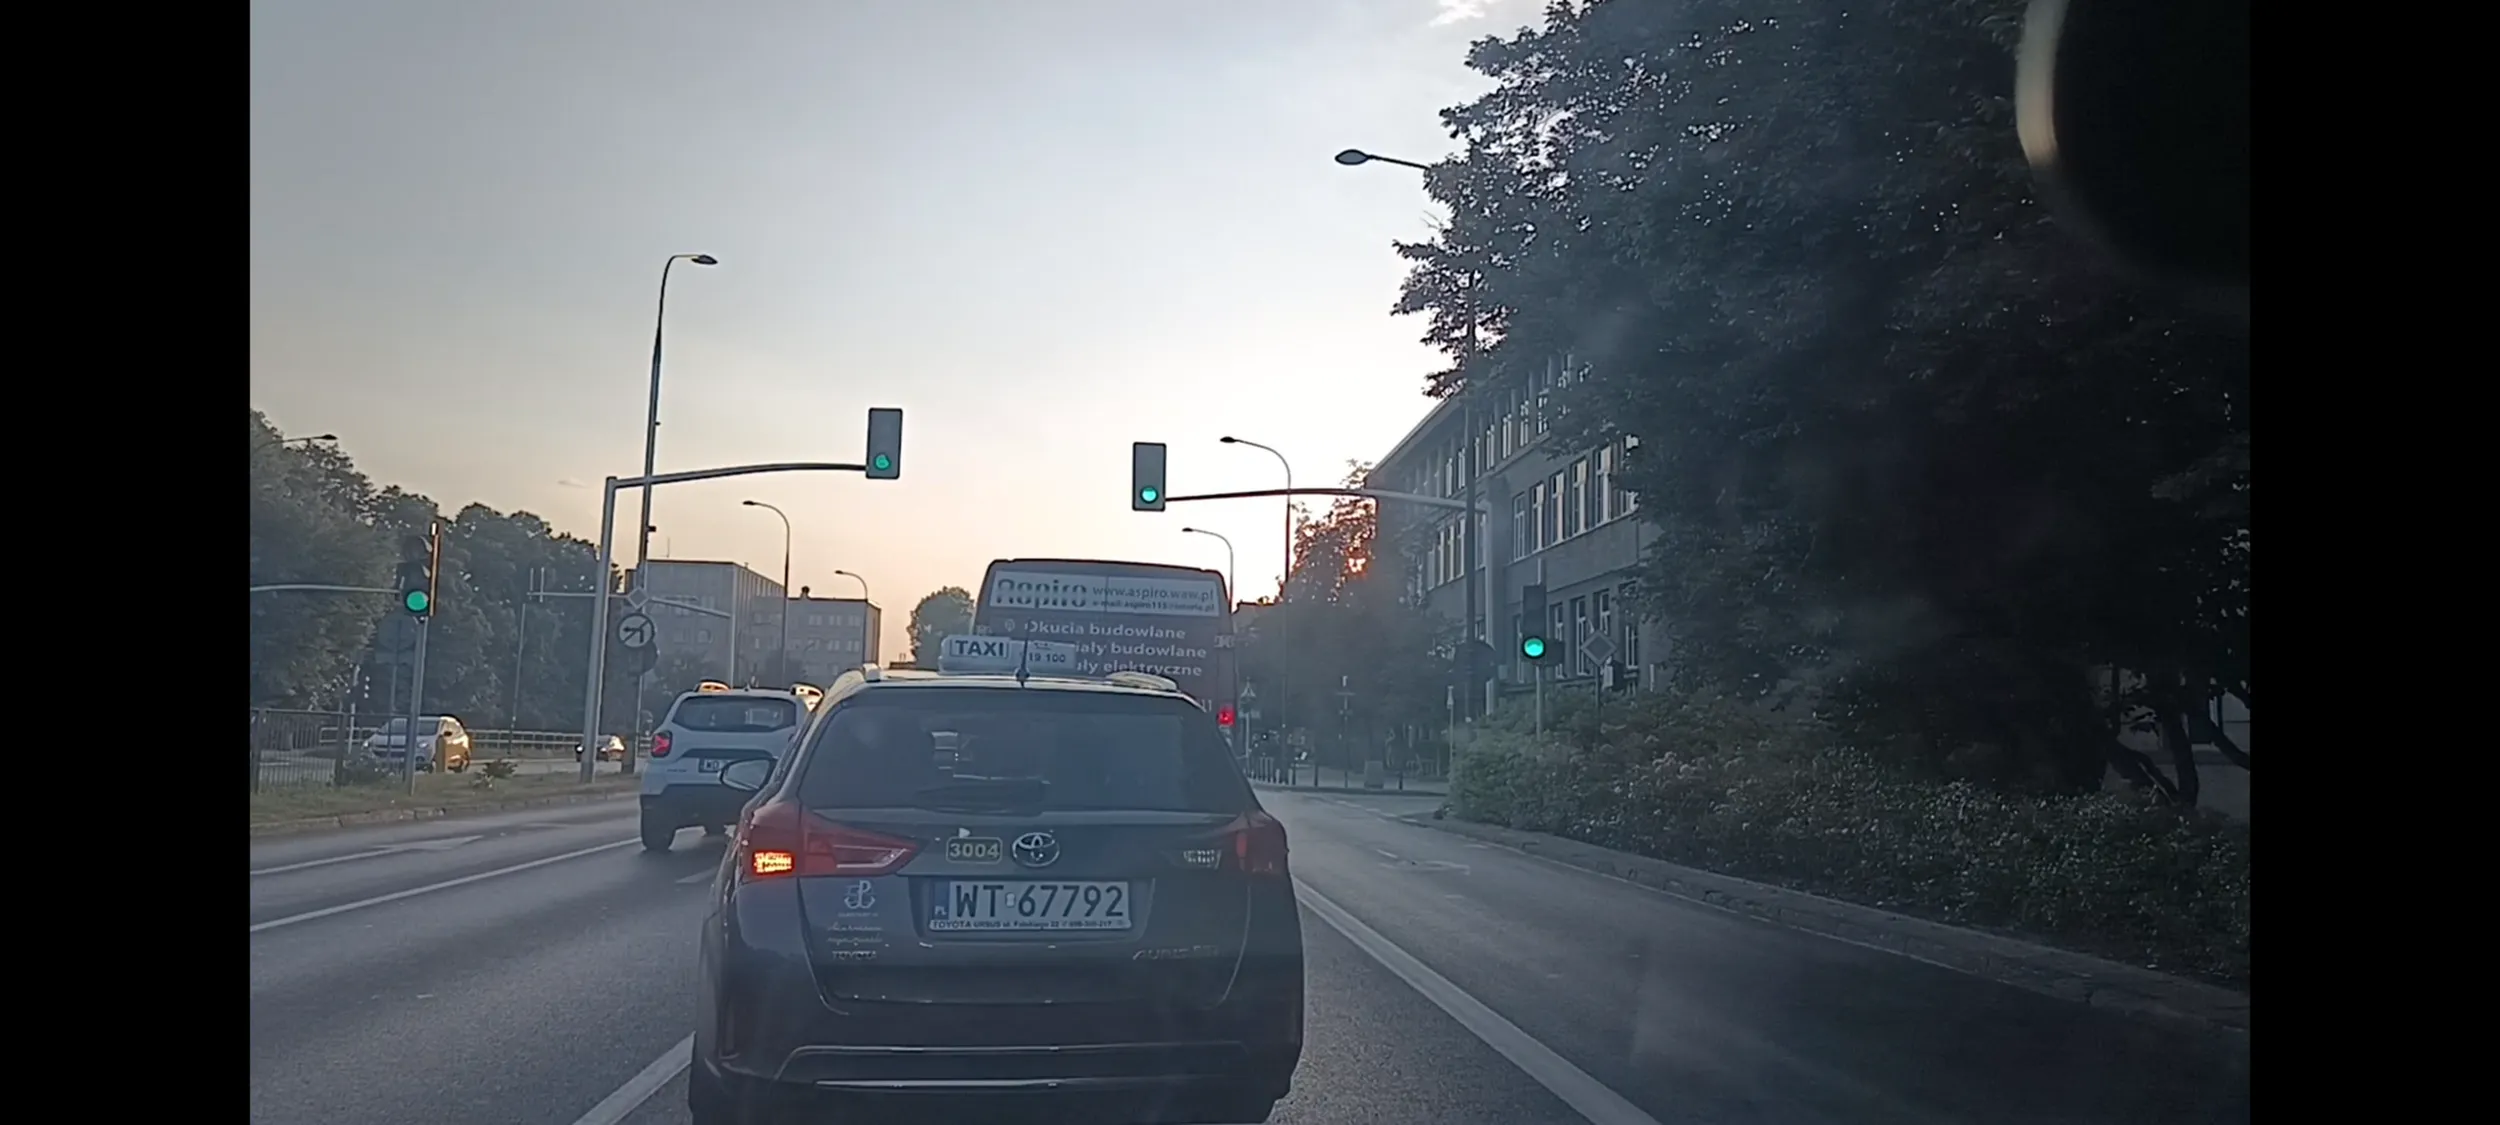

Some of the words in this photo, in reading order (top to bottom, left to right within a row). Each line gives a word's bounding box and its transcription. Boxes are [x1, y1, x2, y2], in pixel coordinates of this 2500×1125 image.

[1024, 620, 1085, 635] Okucia
[1090, 623, 1186, 640] budowlane
[955, 640, 1004, 657] TAXI
[1111, 641, 1207, 659] budowlane
[1046, 653, 1066, 663] 100
[1103, 659, 1203, 677] elektryczne
[950, 843, 1000, 858] 3004
[955, 884, 1004, 918] WT
[1018, 884, 1123, 918] 67792
[932, 920, 972, 928] TOYOTA
